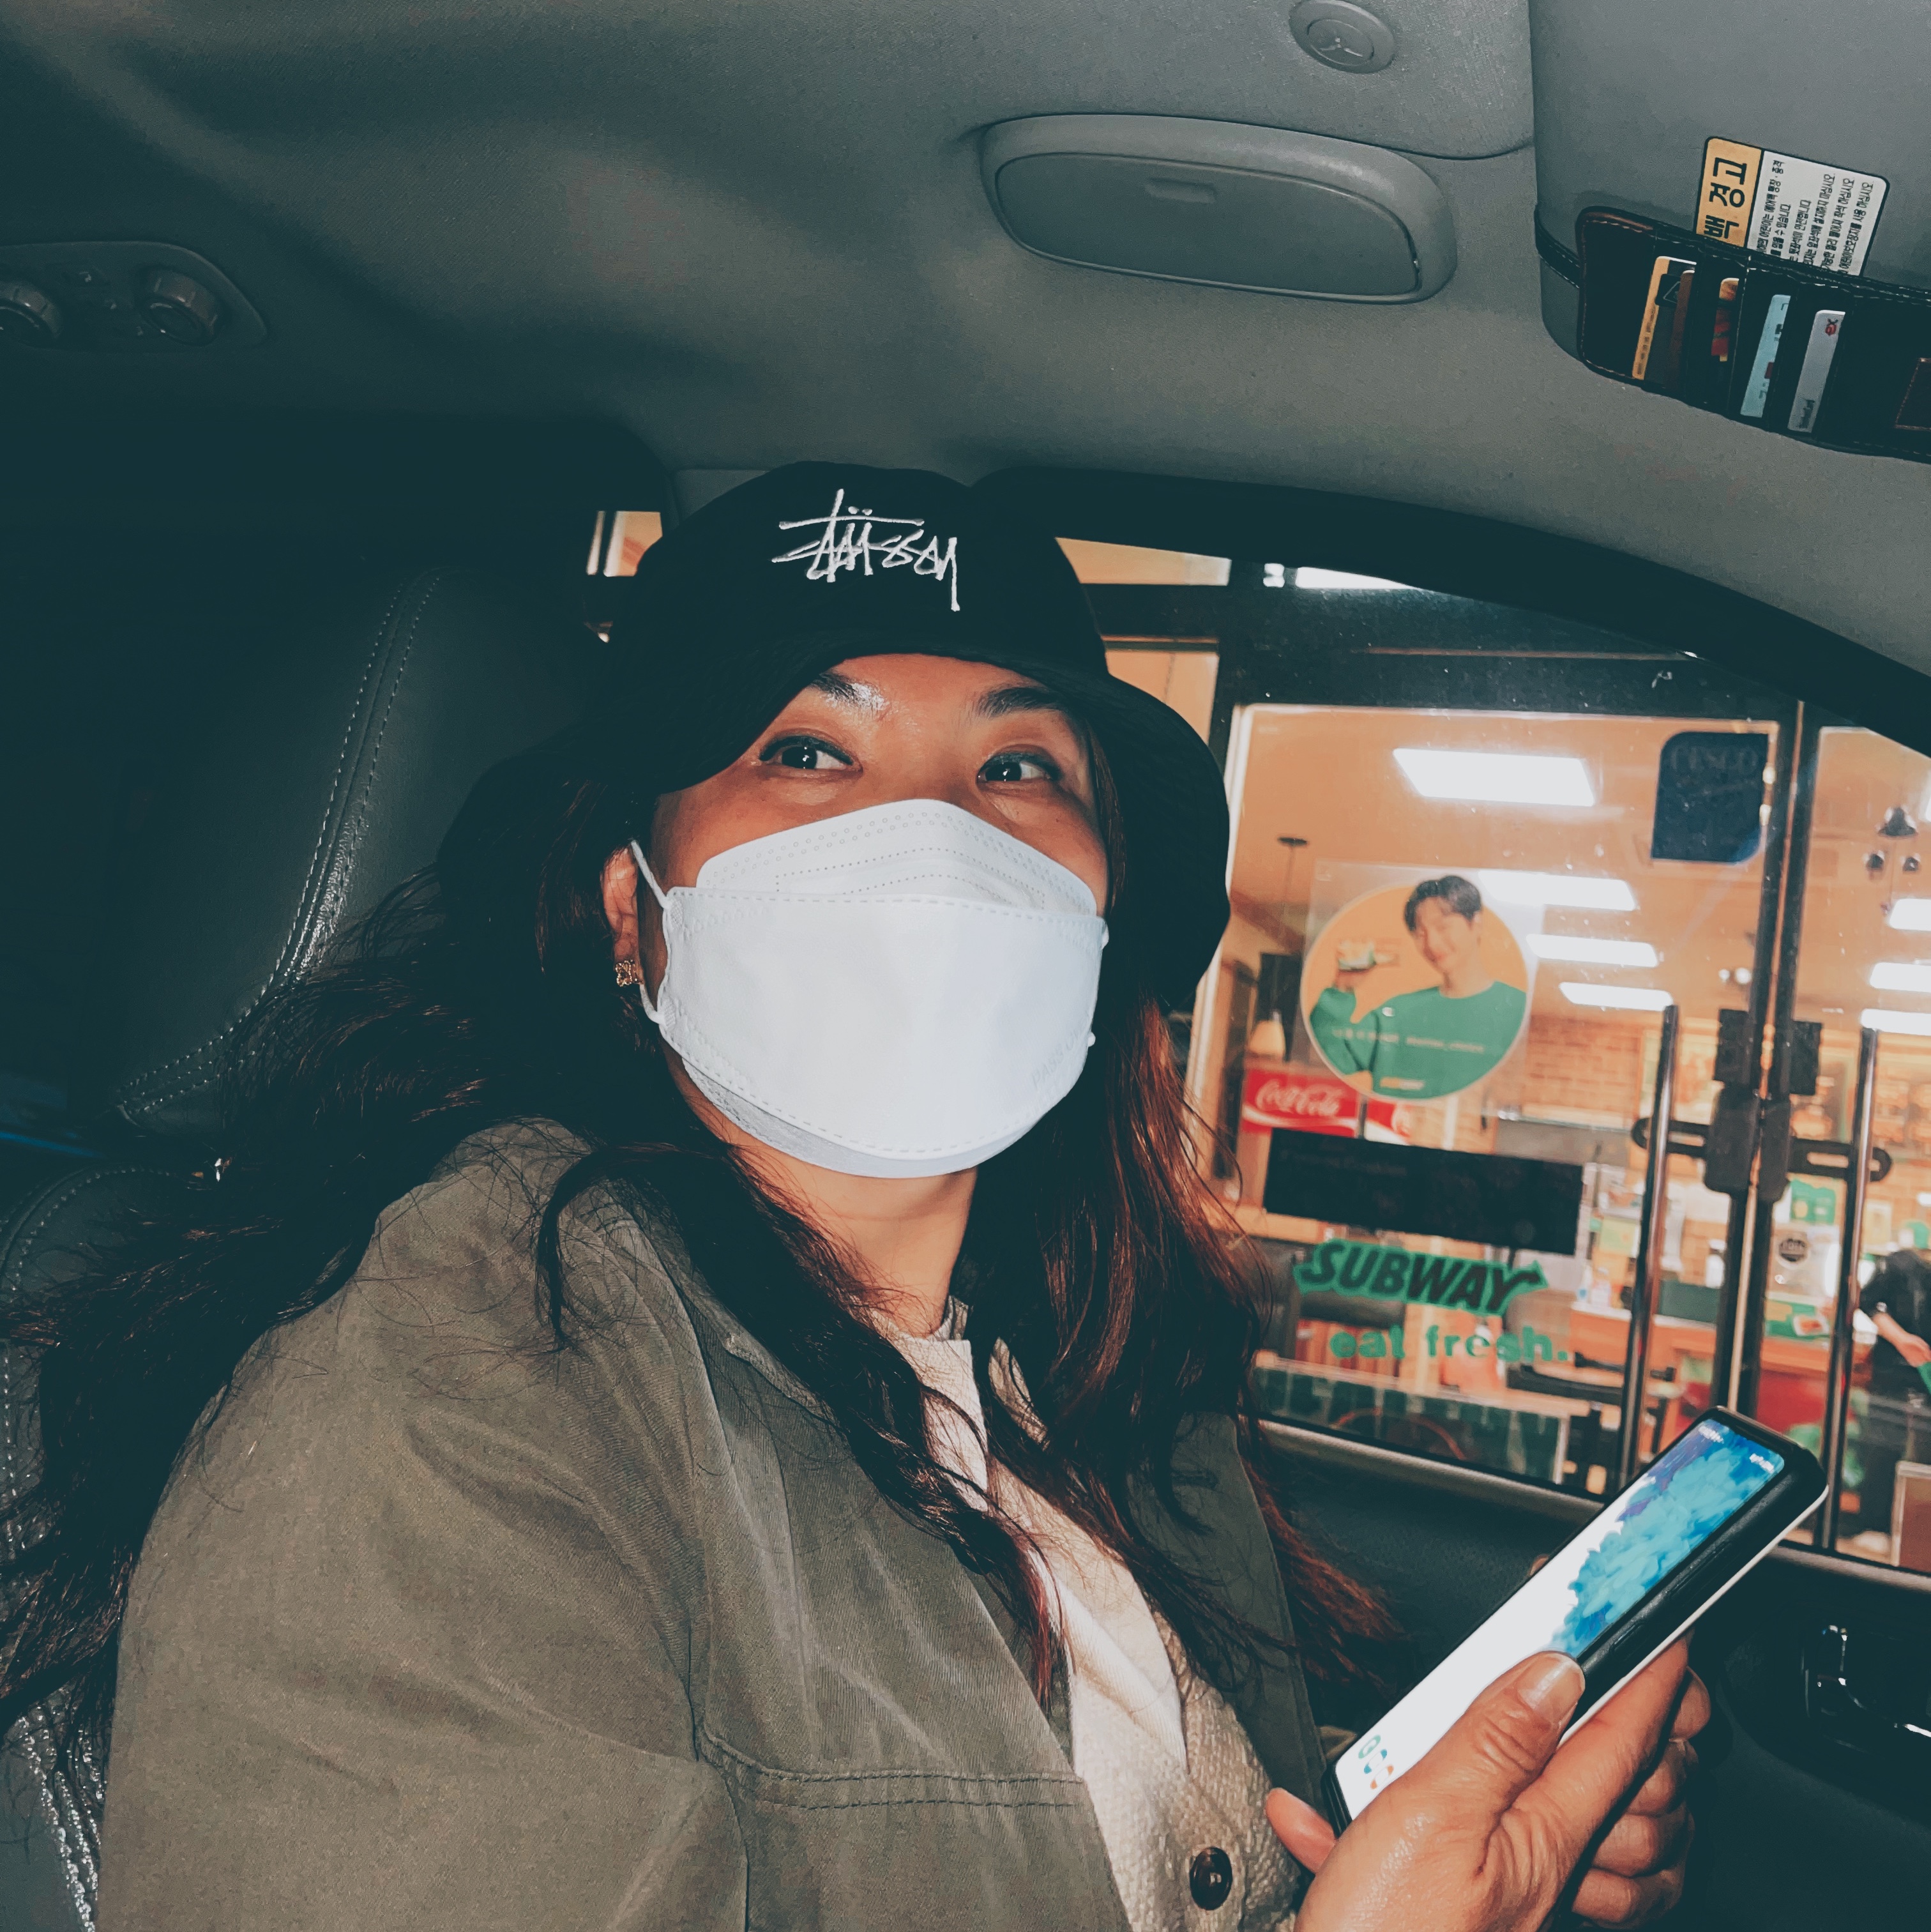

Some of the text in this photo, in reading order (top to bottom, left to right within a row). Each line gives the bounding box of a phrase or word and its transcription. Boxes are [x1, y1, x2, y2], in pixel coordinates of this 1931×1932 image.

[1704, 157, 1746, 240] 백 경고
[1759, 214, 1774, 238] 어린이는
[1768, 179, 1781, 192] 팽창
[1852, 209, 1866, 222] 사용
[1300, 1239, 1543, 1314] SUBWAY
[1329, 1325, 1568, 1362] eat fresh.
